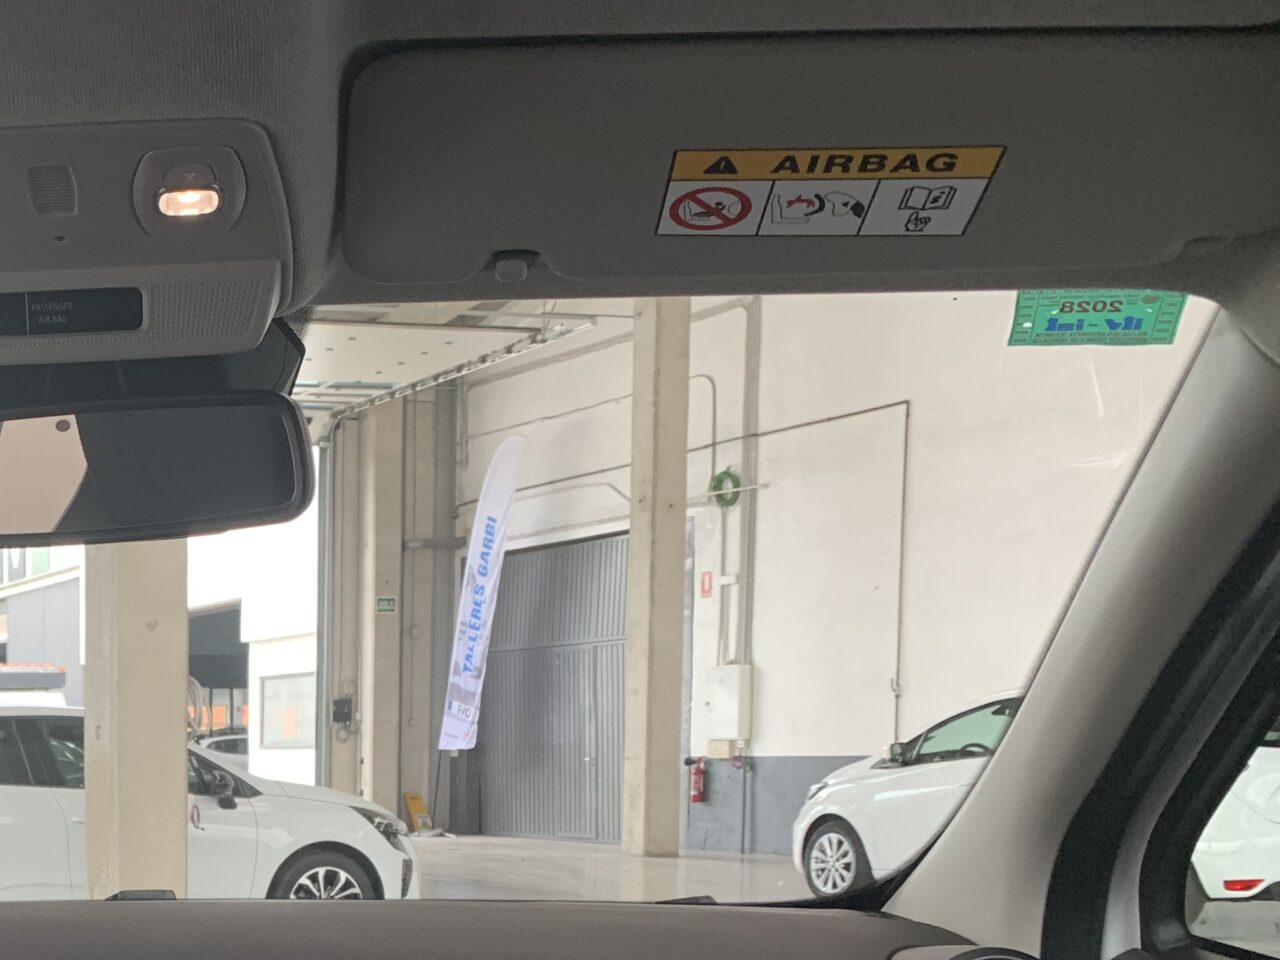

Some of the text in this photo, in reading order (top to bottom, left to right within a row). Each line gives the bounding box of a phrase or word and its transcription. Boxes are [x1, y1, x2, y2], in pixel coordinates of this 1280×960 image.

[771, 152, 960, 174] AIRBAG
[462, 515, 498, 675] TALLERES GARBI
